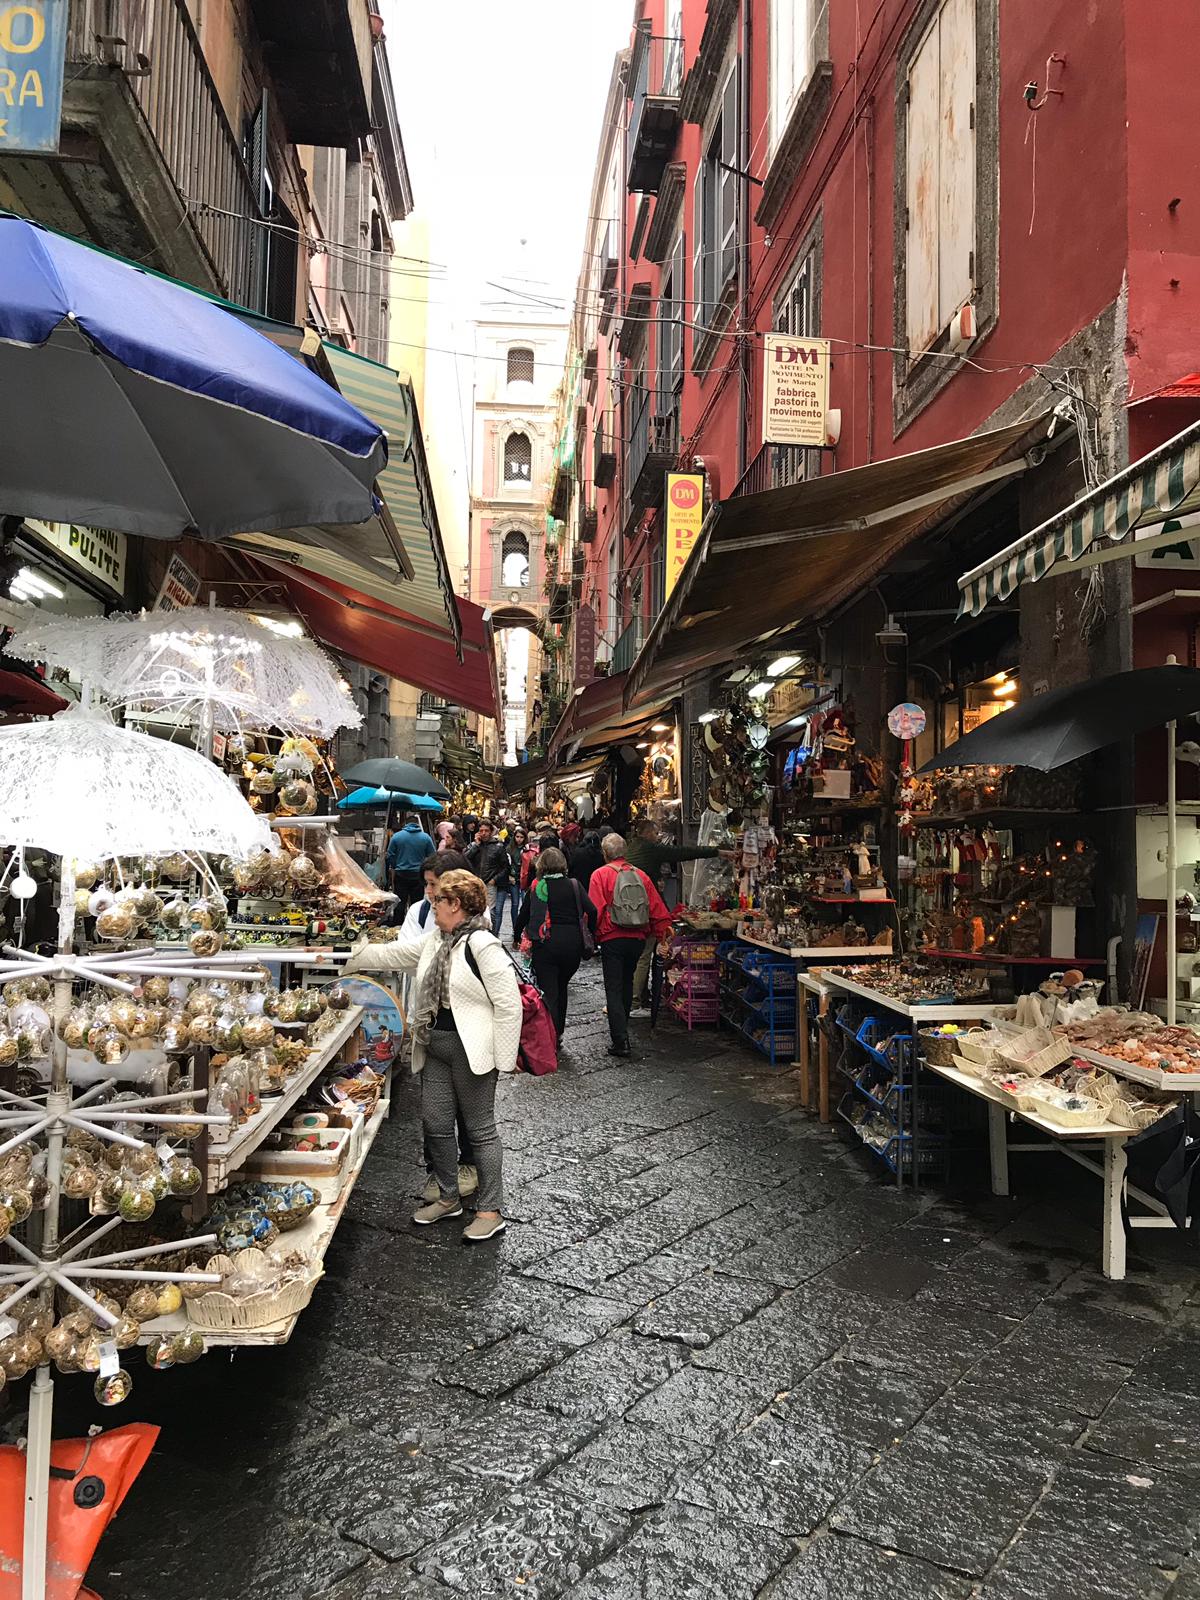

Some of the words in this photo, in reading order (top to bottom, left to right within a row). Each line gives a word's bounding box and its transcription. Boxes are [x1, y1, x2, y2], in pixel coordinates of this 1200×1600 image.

[775, 346, 819, 365] DM
[771, 370, 823, 379] MOVIMENTO
[777, 387, 816, 398] fabbrica
[774, 397, 807, 407] pastori
[810, 398, 819, 408] in
[769, 407, 822, 418] movimento
[675, 488, 695, 500] DM
[69, 524, 119, 582] PULITE
[579, 620, 591, 680] CAPUANO
[692, 736, 703, 820] CAPUANO
